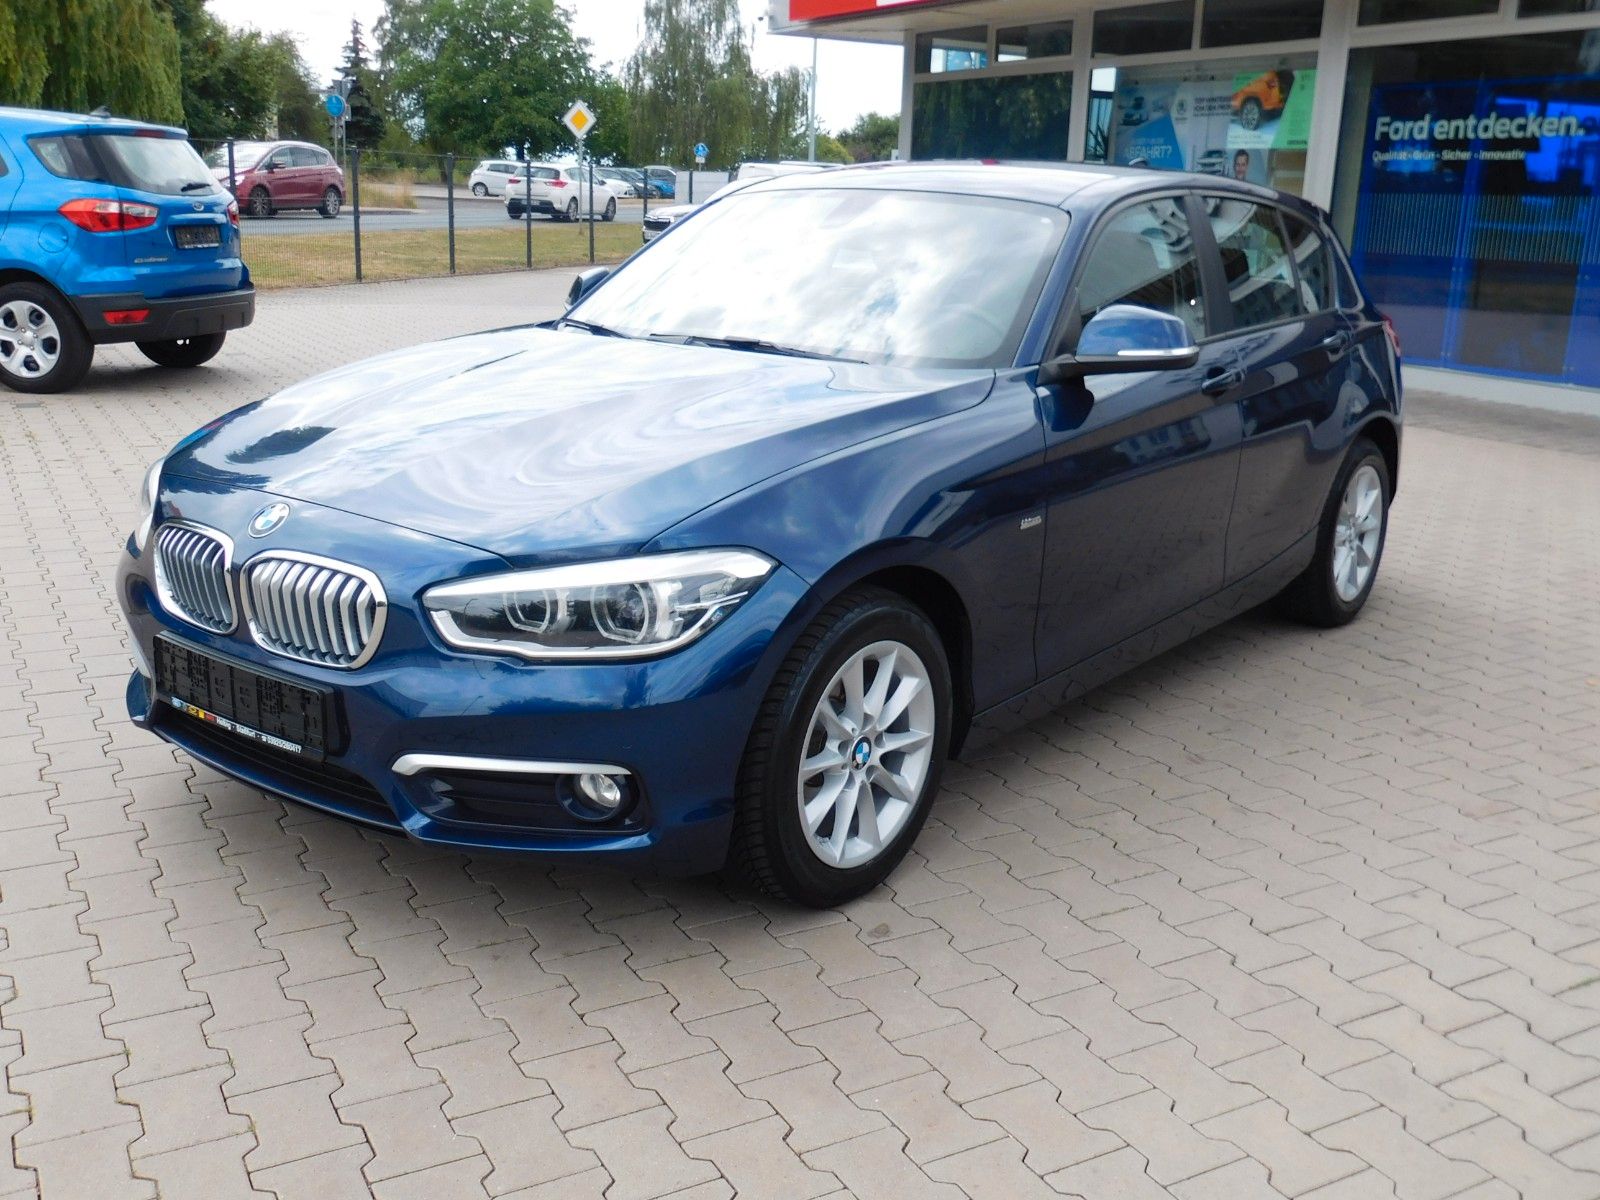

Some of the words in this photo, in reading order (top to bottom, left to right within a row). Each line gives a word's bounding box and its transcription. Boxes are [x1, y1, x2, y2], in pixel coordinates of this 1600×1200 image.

[1374, 114, 1432, 141] Ford
[1433, 112, 1585, 141] entdecken.
[1441, 149, 1472, 161] Sicher
